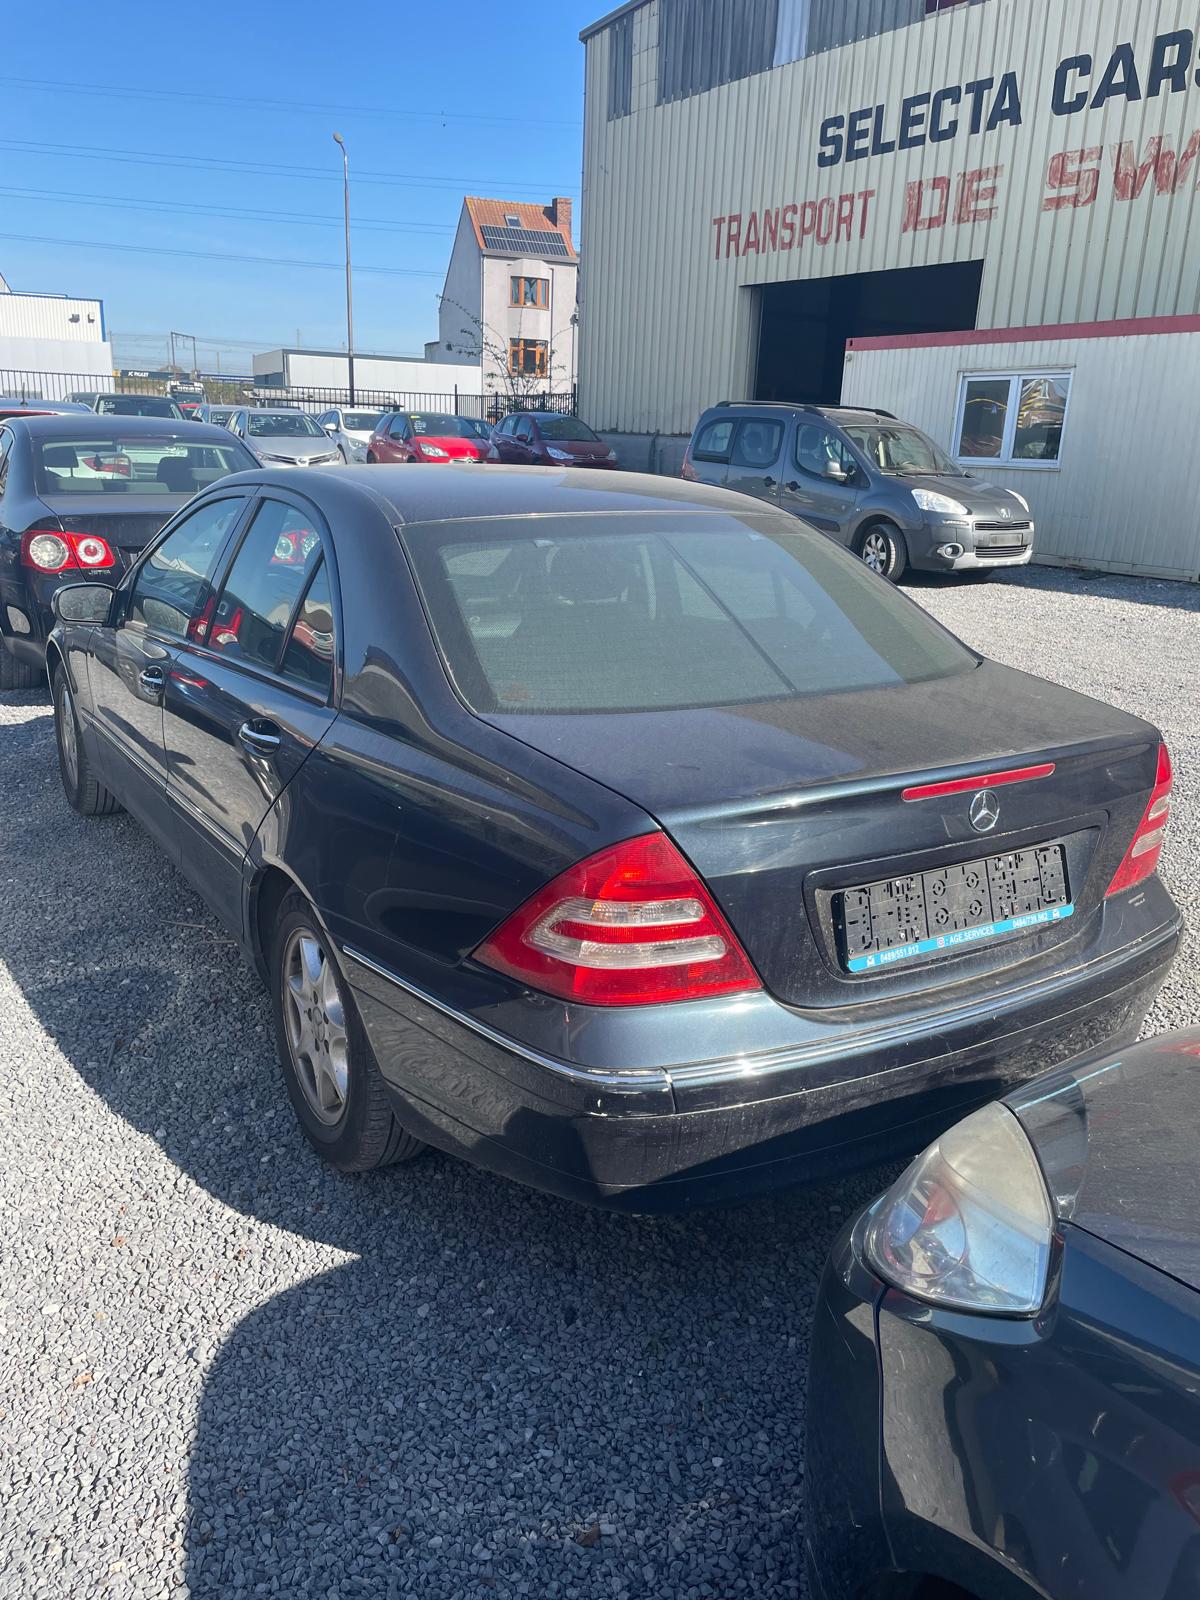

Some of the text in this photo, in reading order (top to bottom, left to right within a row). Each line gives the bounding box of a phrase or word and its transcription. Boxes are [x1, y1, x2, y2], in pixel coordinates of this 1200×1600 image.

[817, 29, 1200, 168] SELECTA CAR
[713, 189, 875, 260] TRANSPORT
[902, 164, 1004, 233] DE
